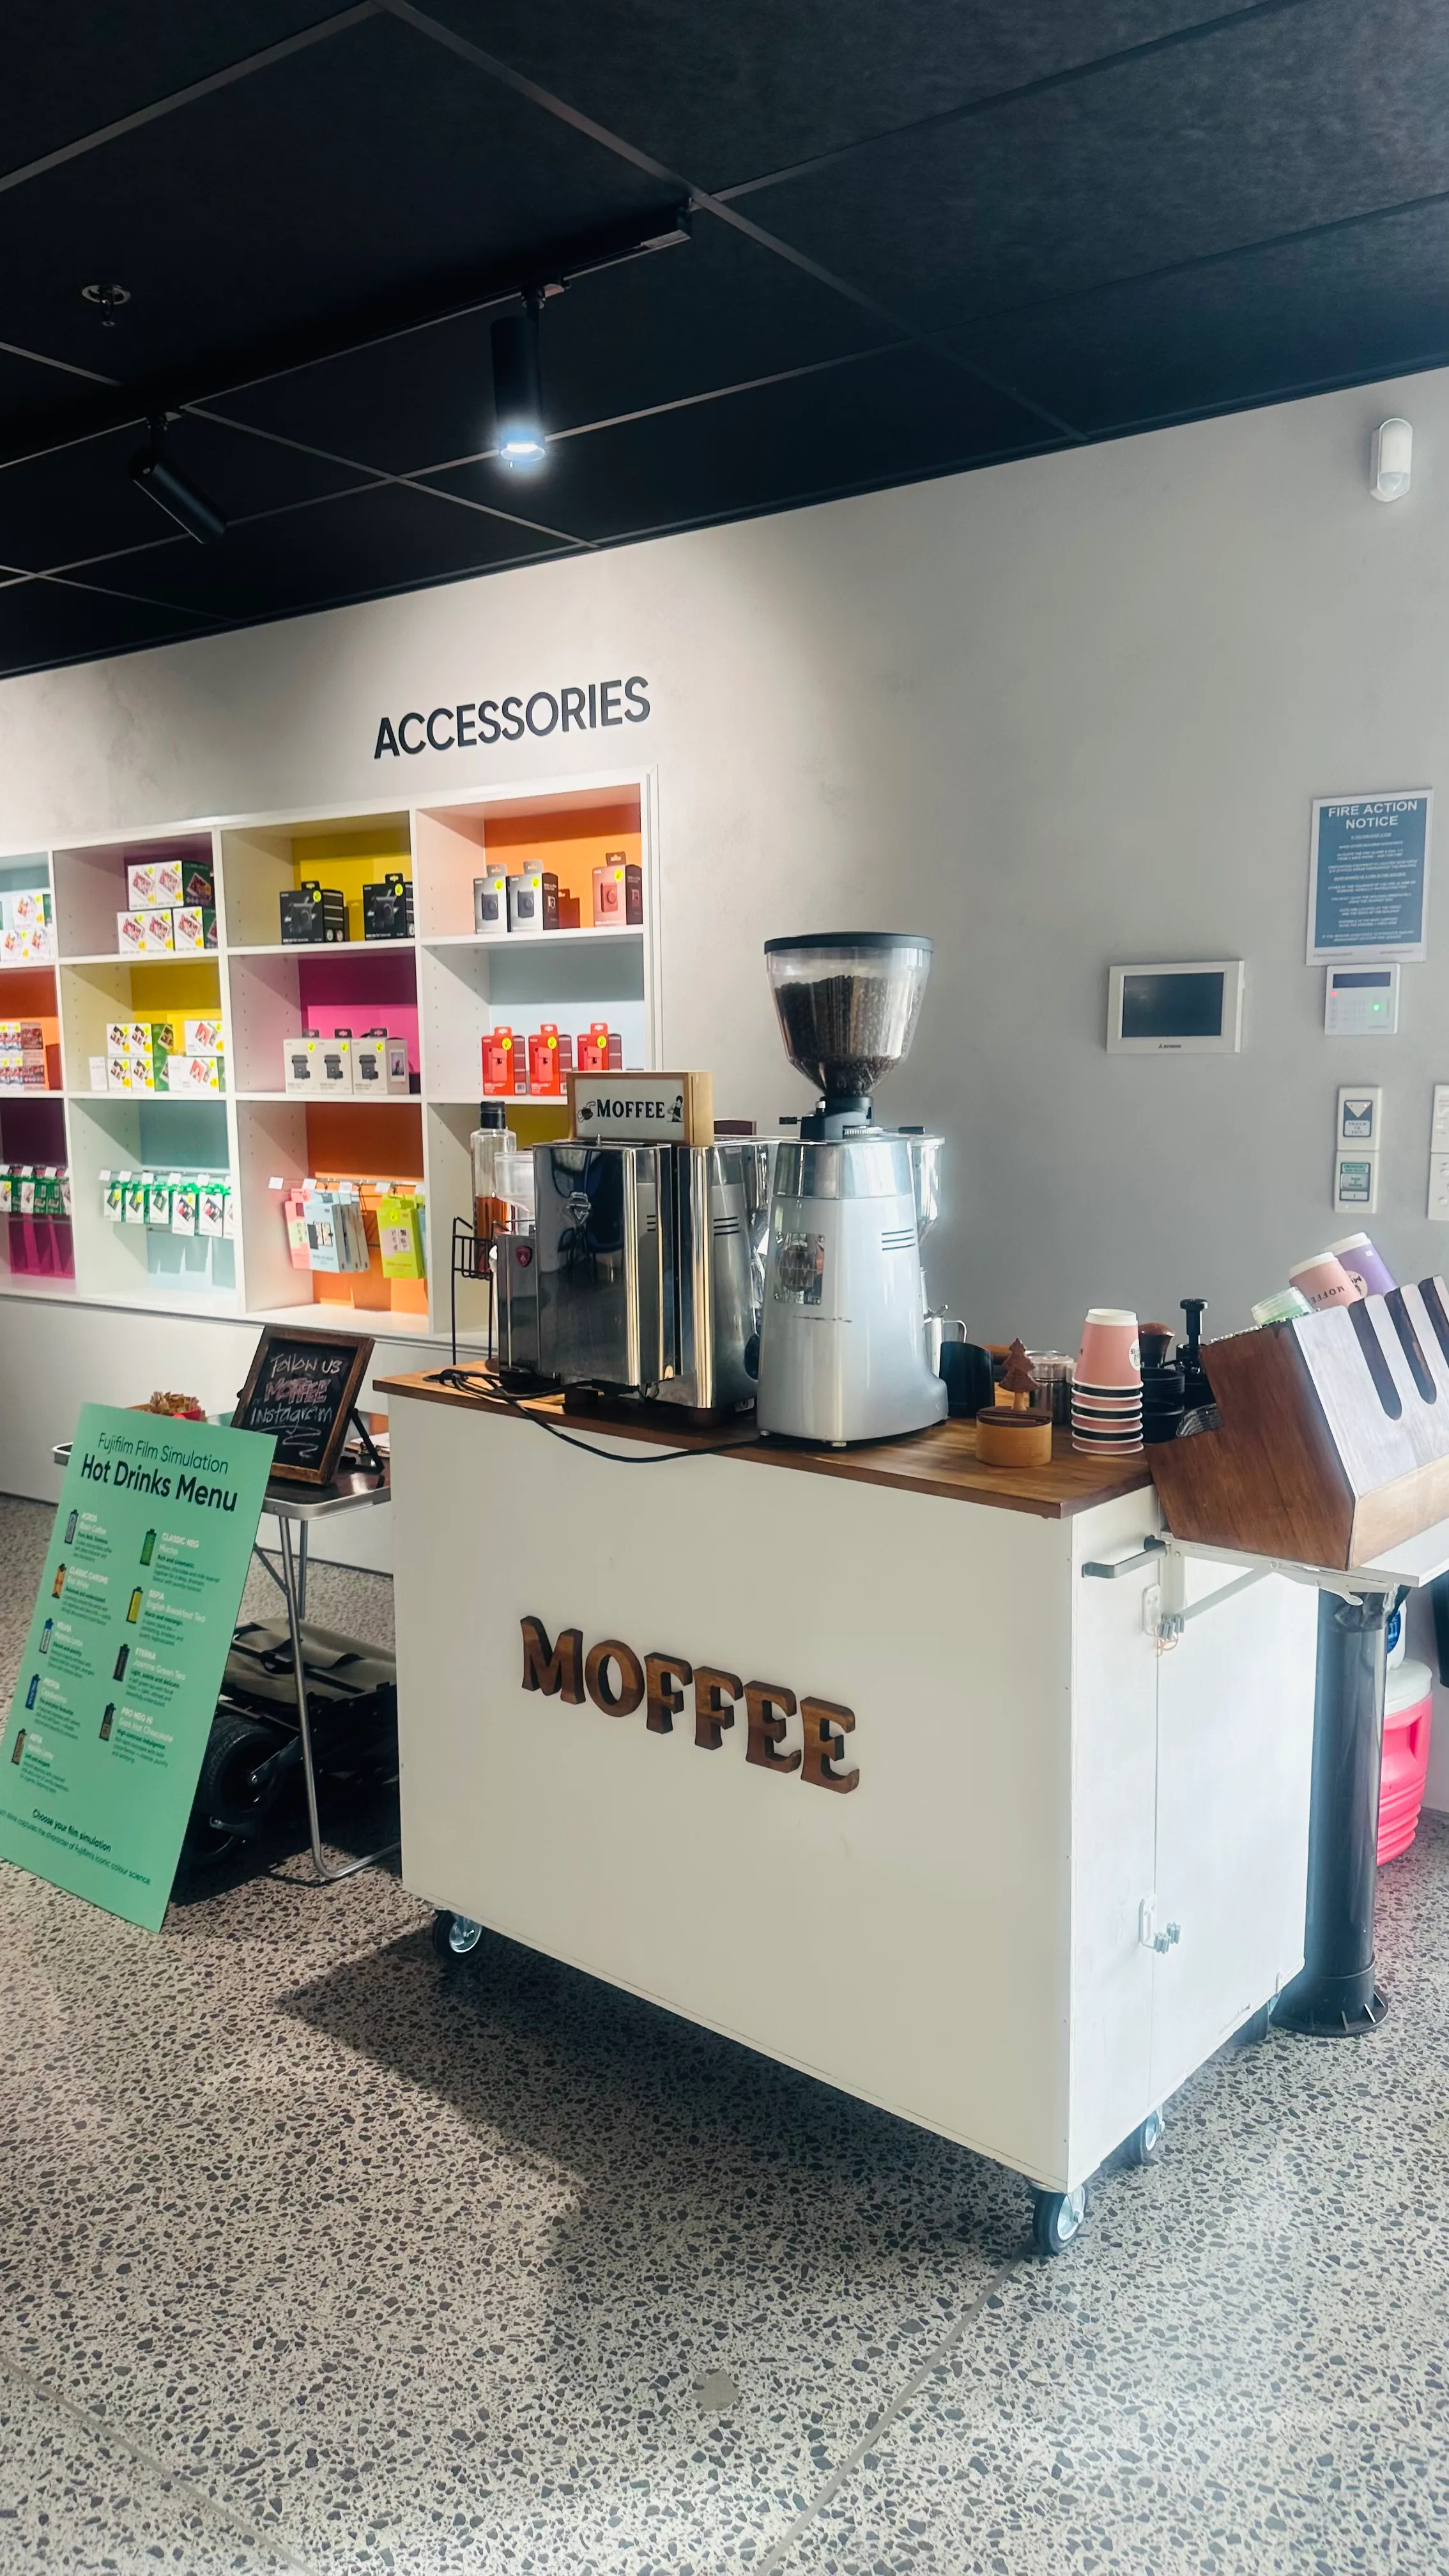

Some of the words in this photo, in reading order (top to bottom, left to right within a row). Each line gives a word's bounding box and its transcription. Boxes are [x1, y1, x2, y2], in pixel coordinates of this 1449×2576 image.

[374, 676, 651, 760] ACCESSORIES
[1328, 805, 1360, 818] FIRE
[1363, 800, 1418, 815] ACTION
[1346, 815, 1399, 829] NOTICE
[597, 1099, 665, 1119] MOFFEE
[1310, 1285, 1346, 1305] MOFFE
[98, 1432, 134, 1456] Fujifilm
[135, 1440, 158, 1460] Film
[160, 1445, 229, 1475] Simulation
[80, 1453, 111, 1483] Hot
[114, 1461, 171, 1497] Drinks
[176, 1474, 238, 1512] Menu
[162, 1533, 185, 1545] CLASSIC
[520, 1615, 860, 1794] MOFFEE
[32, 1809, 54, 1826] Choose
[54, 1820, 67, 1834] your
[67, 1825, 79, 1837] film
[79, 1830, 112, 1853] simulation
